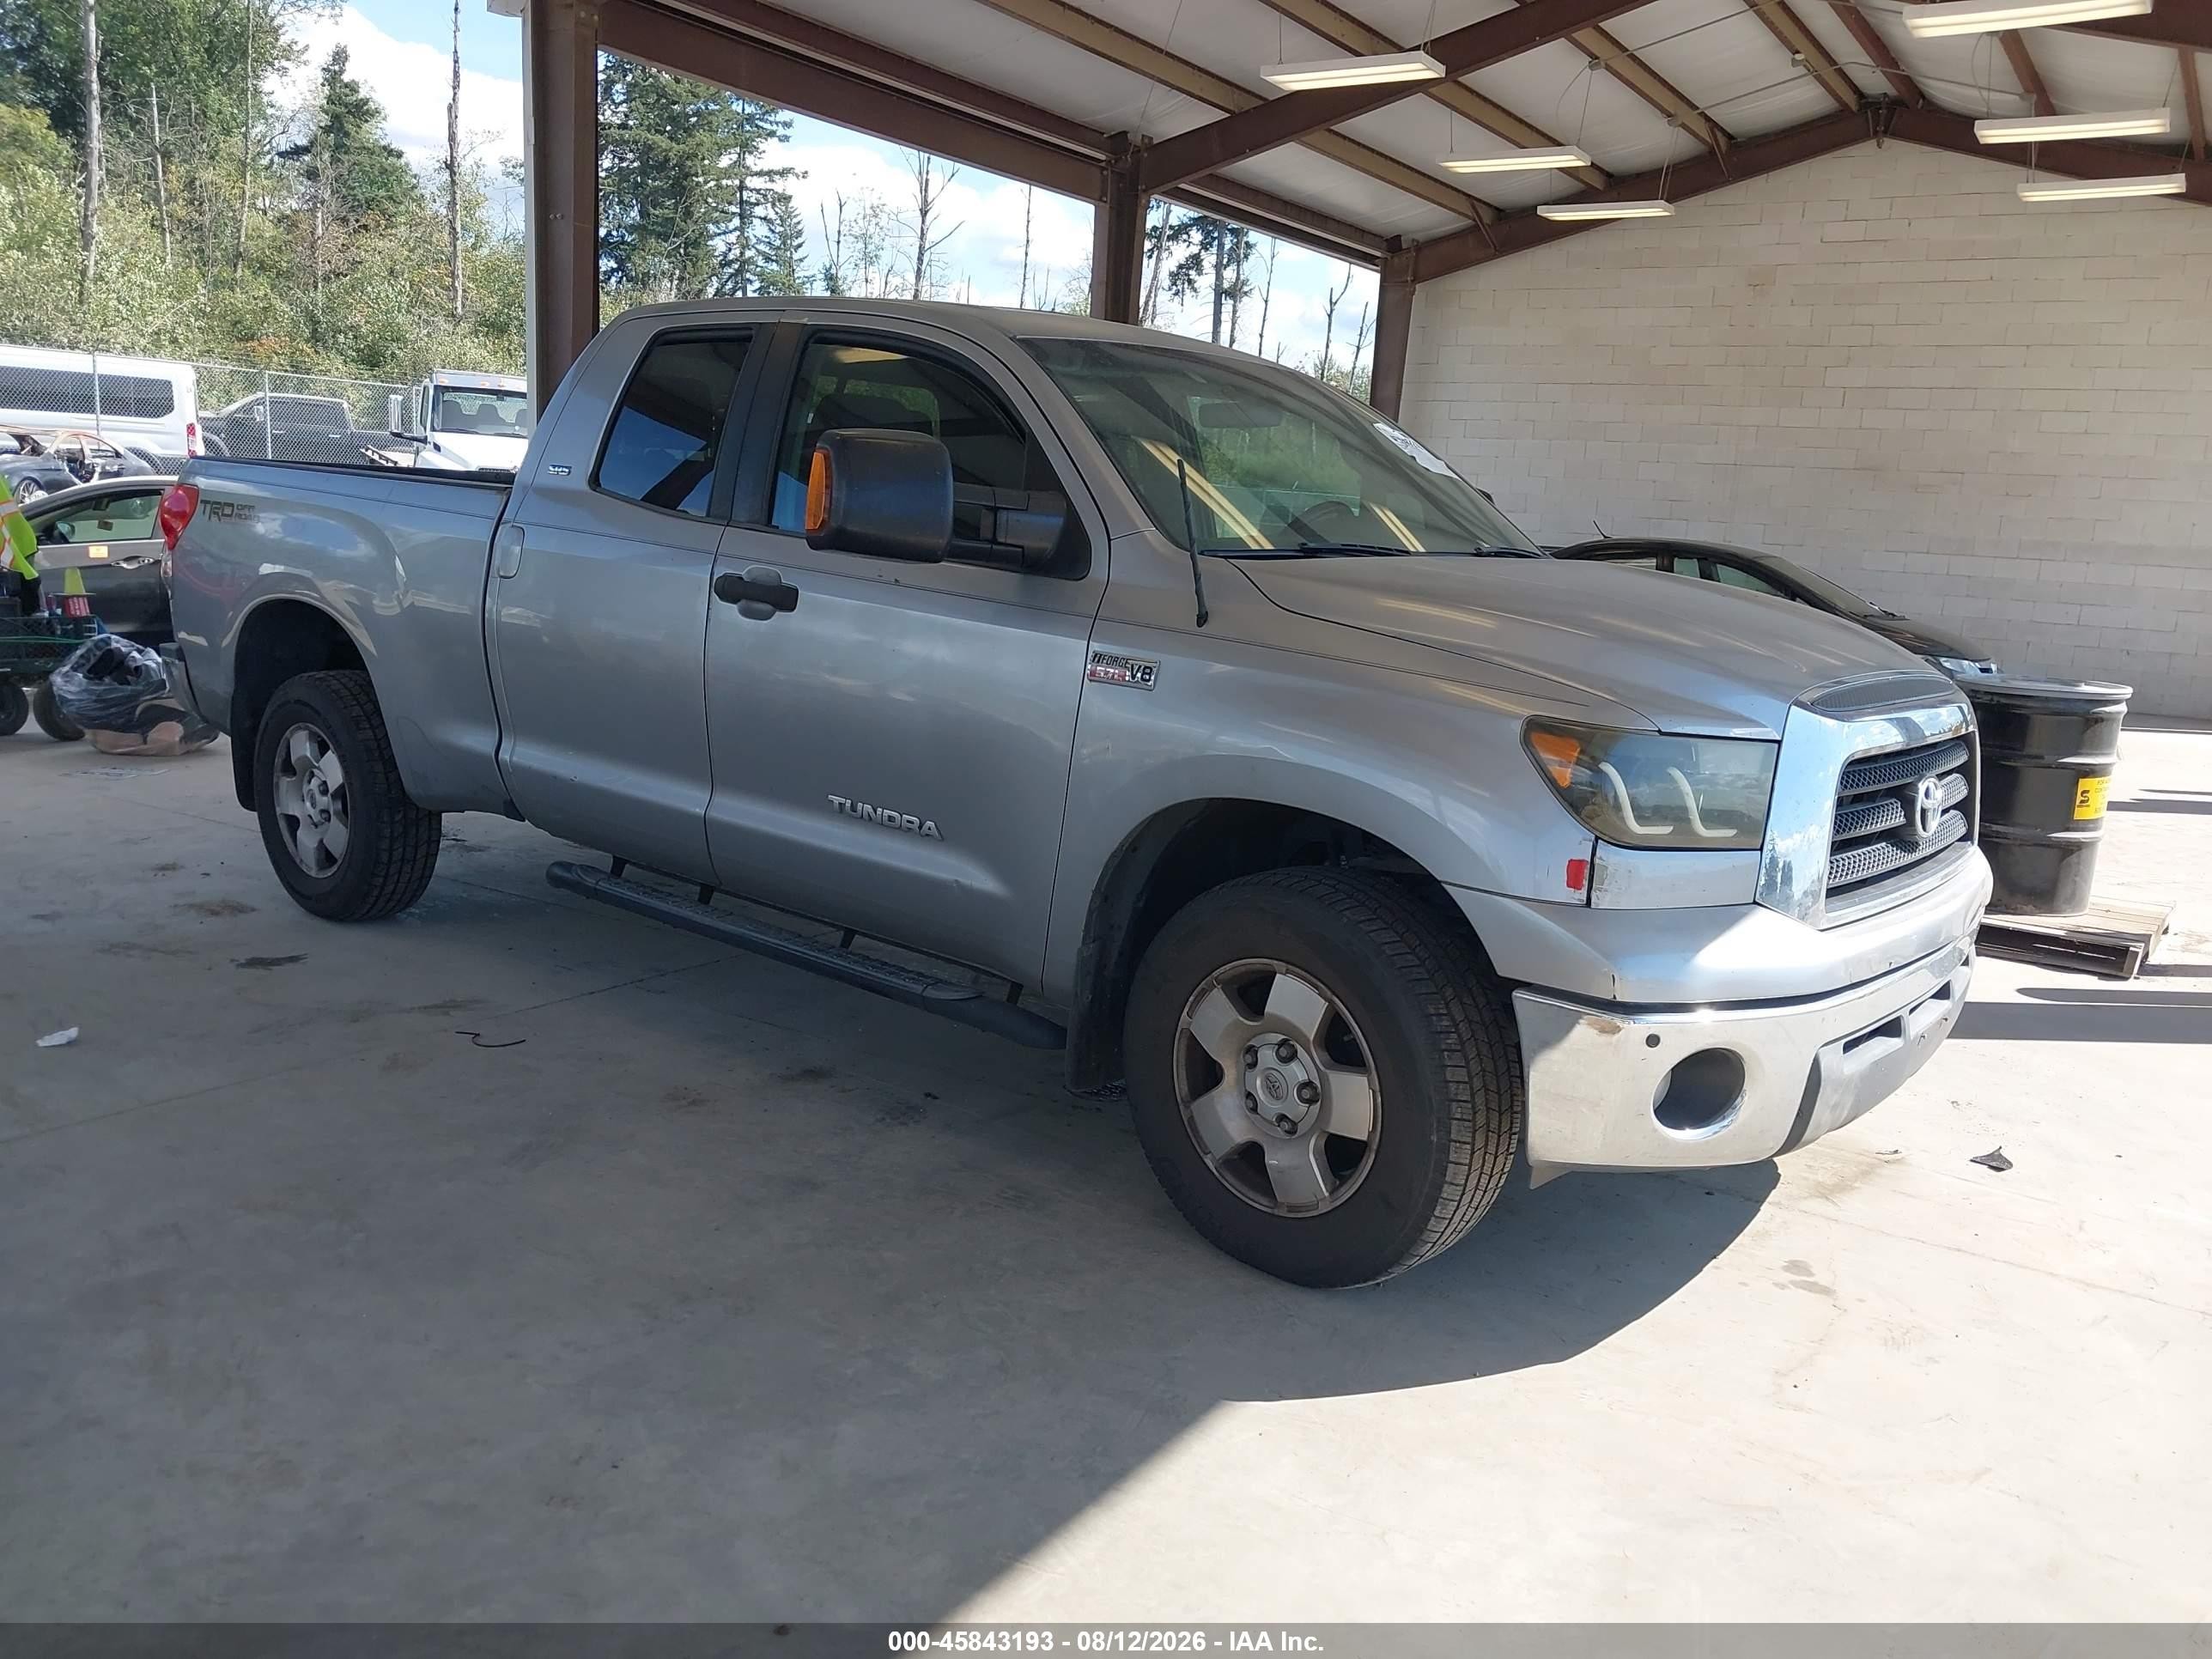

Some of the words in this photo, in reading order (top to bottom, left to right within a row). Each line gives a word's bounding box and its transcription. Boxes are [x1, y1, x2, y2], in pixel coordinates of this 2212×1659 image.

[200, 500, 234, 521] TRD
[1130, 663, 1153, 683] V8
[827, 794, 943, 841] TUNDRA
